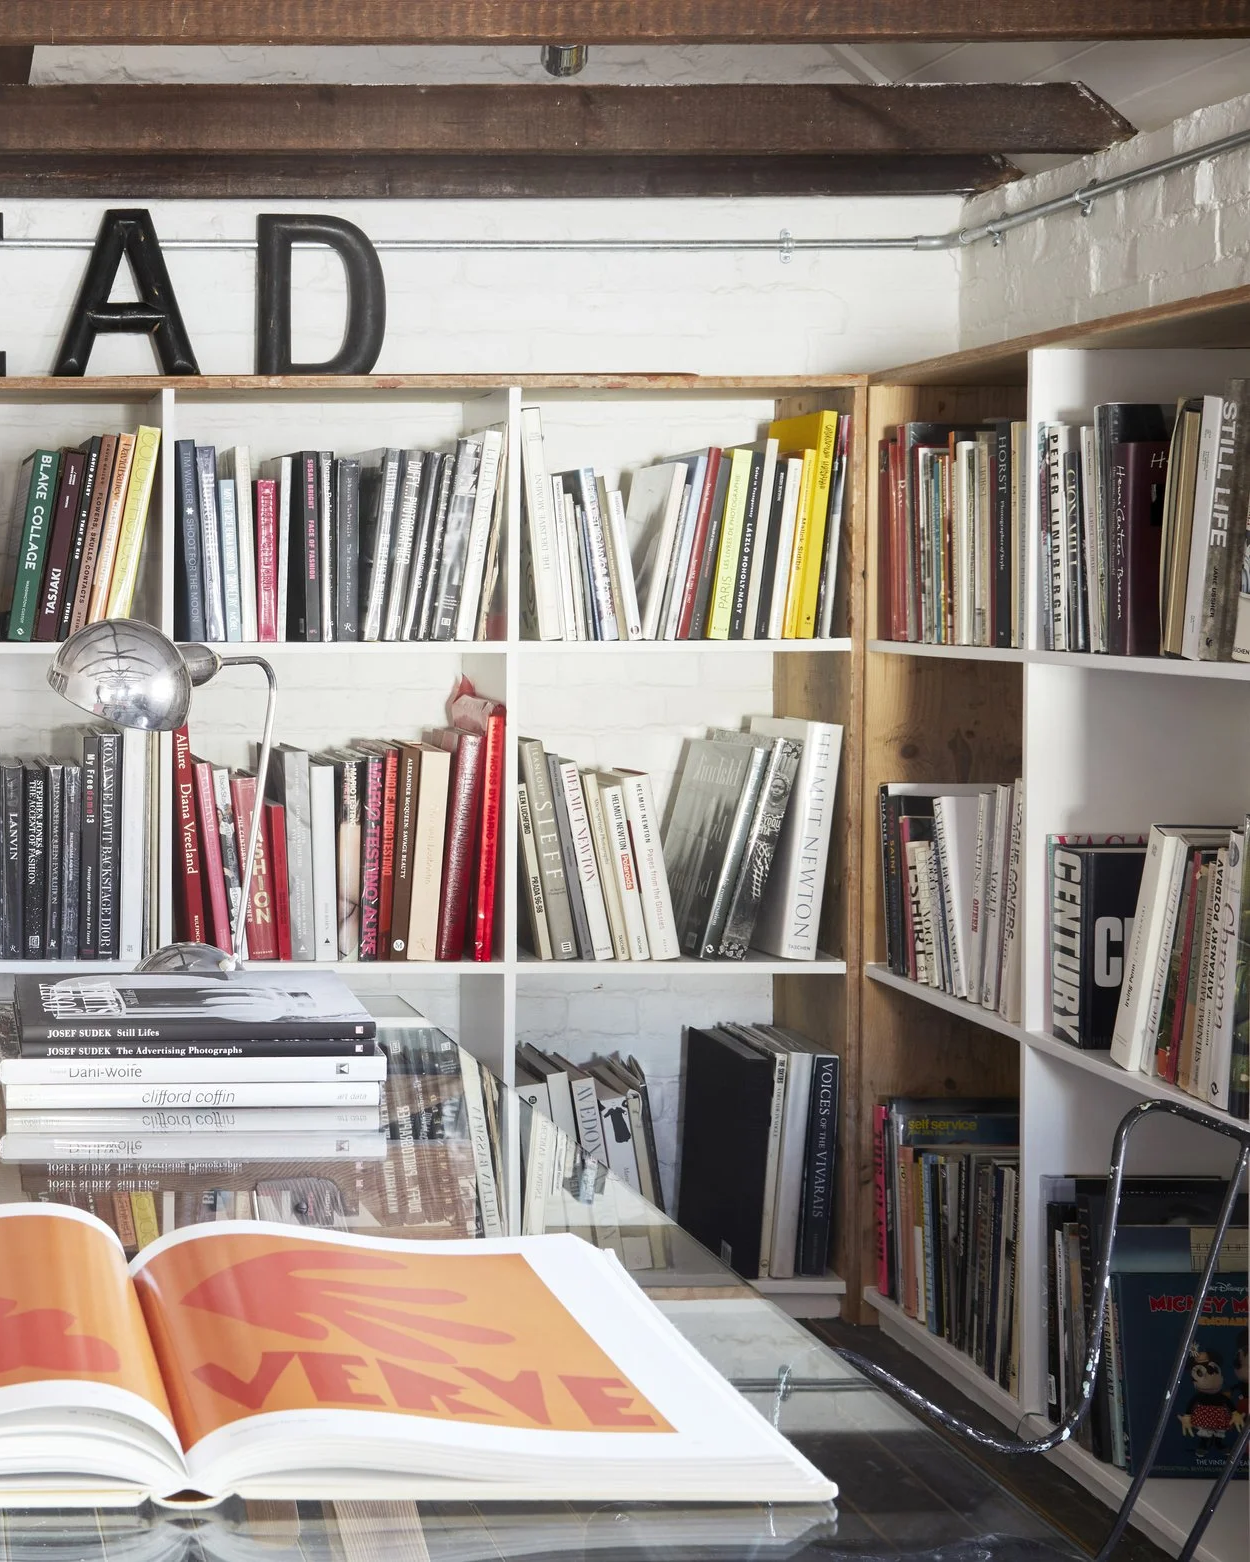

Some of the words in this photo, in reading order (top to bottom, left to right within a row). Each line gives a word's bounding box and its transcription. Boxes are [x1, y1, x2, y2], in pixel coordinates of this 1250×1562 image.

[1216, 401, 1238, 480] STILL
[89, 453, 97, 473] DAVID
[183, 451, 191, 468] TIM
[307, 459, 315, 483] SUSAN
[998, 436, 1006, 494] HORST
[1050, 434, 1060, 495] PETER
[35, 454, 52, 500] BLAKE
[85, 473, 95, 497] BAILEY
[184, 469, 194, 505] WALKER
[307, 485, 315, 510] BRIGHT
[535, 474, 546, 511] MOMENT
[748, 487, 756, 518] Transparency
[78, 519, 86, 535] THAT
[308, 520, 316, 537] FACE
[799, 517, 807, 543] Malick
[1210, 486, 1231, 548] LIFE
[24, 505, 45, 571] COLLAGE
[76, 537, 84, 547] SO
[186, 518, 196, 550] SHOOT
[308, 539, 316, 549] OF
[538, 515, 550, 552] DECISIVE
[743, 523, 754, 553] LÁSZLÓ
[188, 553, 197, 572] FOR
[308, 550, 316, 580] FASHION
[543, 557, 552, 572] THE
[795, 545, 804, 571] Sidibé
[1052, 508, 1062, 624] LINDBERGH
[45, 567, 62, 615] TASJAKI
[190, 574, 198, 591] THE
[735, 555, 749, 614] MOHOLY-NAGY
[1211, 566, 1220, 587] JANE
[63, 602, 72, 624] STEIDL
[191, 592, 199, 622] MOON
[1209, 588, 1218, 618] USSHER
[176, 733, 190, 769] Allure
[102, 739, 115, 801] ROXANNE
[387, 757, 398, 787] MARIO
[405, 758, 414, 796] ALEXANDER
[806, 732, 831, 827] HELMUT
[28, 780, 37, 799] THE
[35, 780, 44, 819] STEPHEN
[179, 782, 194, 819] Diana
[387, 788, 396, 801] DE
[519, 790, 527, 810] GLEN
[635, 783, 646, 812] HELMUT
[28, 800, 36, 830] ACCENT
[384, 802, 395, 838] JANEIRO
[403, 797, 411, 829] McQUEEN:
[611, 794, 622, 820] HELMUT
[9, 813, 18, 861] LANVIN
[35, 821, 43, 848] JONES
[102, 803, 114, 843] LOWIT
[521, 810, 531, 835] LUCHFORD
[564, 769, 582, 825] HELMUT
[575, 827, 596, 883] NEWTON
[616, 821, 627, 851] NEWTON
[640, 814, 651, 844] NEWTON
[1011, 801, 1023, 865] VOGUE
[28, 831, 36, 846] OF
[183, 821, 199, 875] Vreeland
[401, 830, 409, 853] SAVAGE
[28, 847, 36, 885] FASHION
[383, 838, 393, 876] TESTINO
[645, 848, 655, 871] Pages
[101, 845, 113, 915] BACKSTAGE
[531, 876, 540, 897] PRADA
[622, 855, 632, 890] Polaroids
[649, 871, 658, 889] from
[793, 836, 820, 939] NEWTON
[534, 896, 544, 914] 96-98
[652, 891, 660, 902] the
[712, 889, 727, 926] conversation
[989, 870, 999, 919] VOGUE
[1006, 868, 1019, 941] COVERS
[654, 901, 667, 931] Glossies
[100, 919, 111, 947] DIOR
[787, 943, 812, 952] TASCHEN
[1053, 848, 1082, 1046] CENTURY
[47, 1027, 77, 1039] JOSEF
[78, 1027, 112, 1038] SUDEK
[116, 1027, 135, 1038] Still
[136, 1027, 160, 1038] Lifes
[46, 1046, 77, 1057] JOSEF
[78, 1046, 112, 1056] SUDEK
[116, 1045, 133, 1056] The
[135, 1045, 186, 1058] Advertising
[188, 1045, 243, 1058] Photographs
[141, 1088, 192, 1106] clifford
[194, 1088, 236, 1106] coffin
[336, 1093, 348, 1101] art
[348, 1092, 368, 1101] data
[818, 1062, 834, 1116] VOICES
[576, 1084, 602, 1156] AVEDON
[819, 1117, 827, 1128] OF
[908, 1119, 931, 1131] self
[931, 1119, 978, 1131] service
[817, 1129, 826, 1149] THE
[812, 1150, 828, 1219] VIVARAIS
[191, 1349, 656, 1429] VERVE
